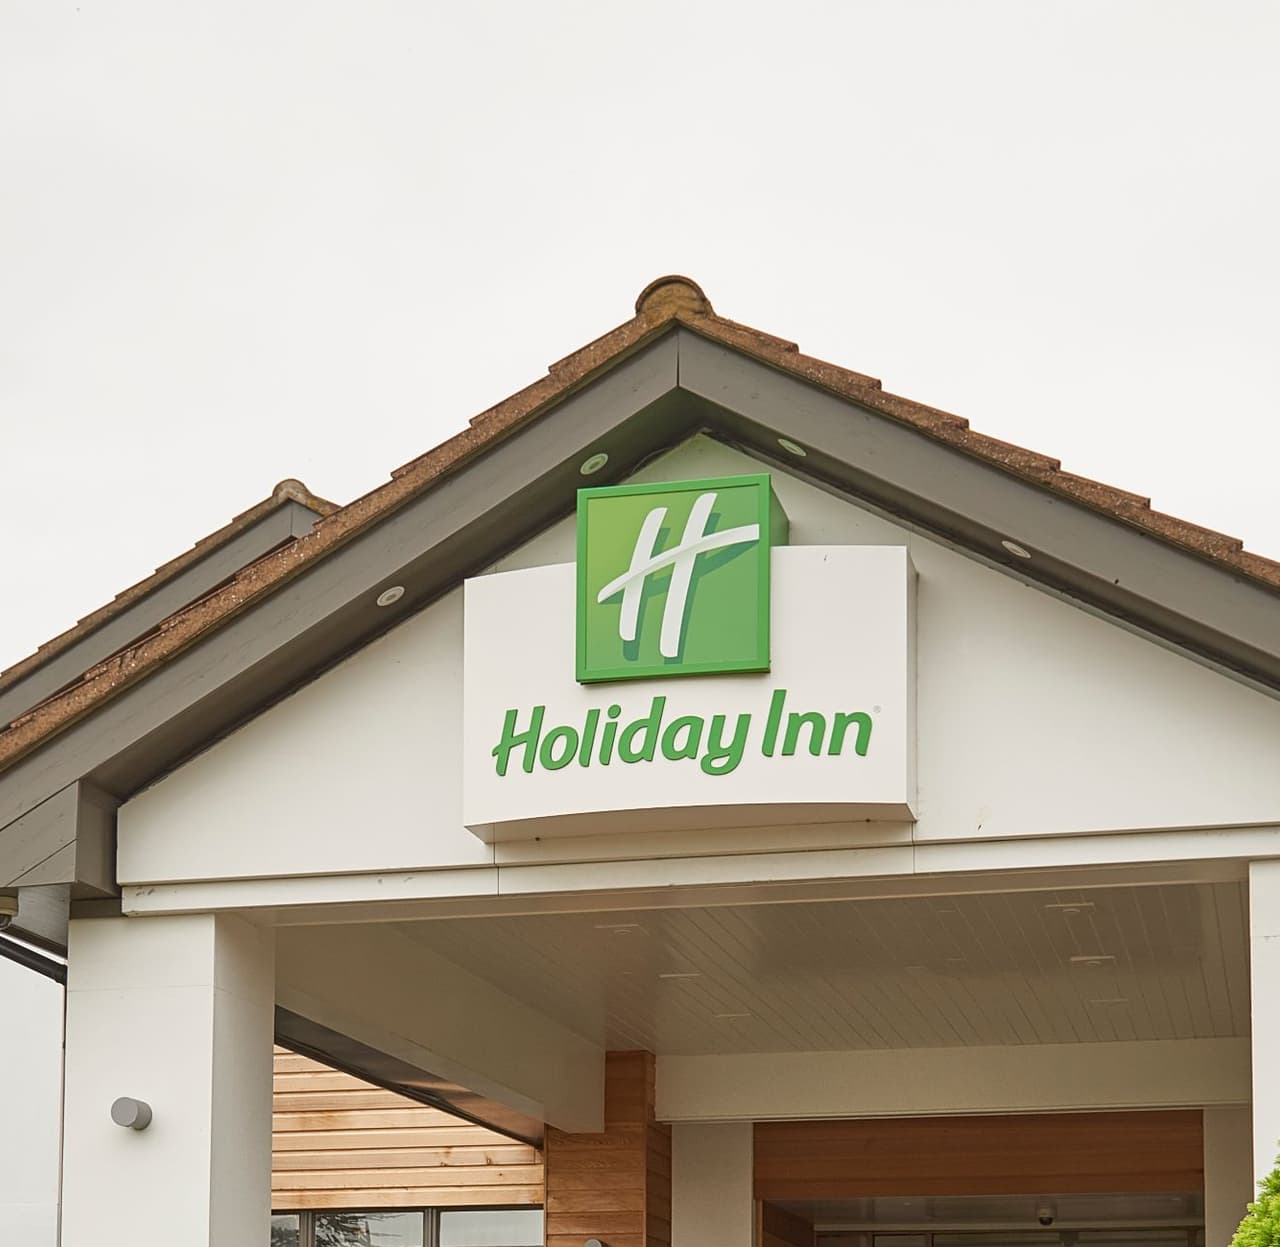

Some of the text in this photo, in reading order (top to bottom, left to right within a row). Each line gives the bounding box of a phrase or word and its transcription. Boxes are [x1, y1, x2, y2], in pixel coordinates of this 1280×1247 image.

[597, 493, 760, 658] H
[492, 689, 873, 776] Holiday Inn
